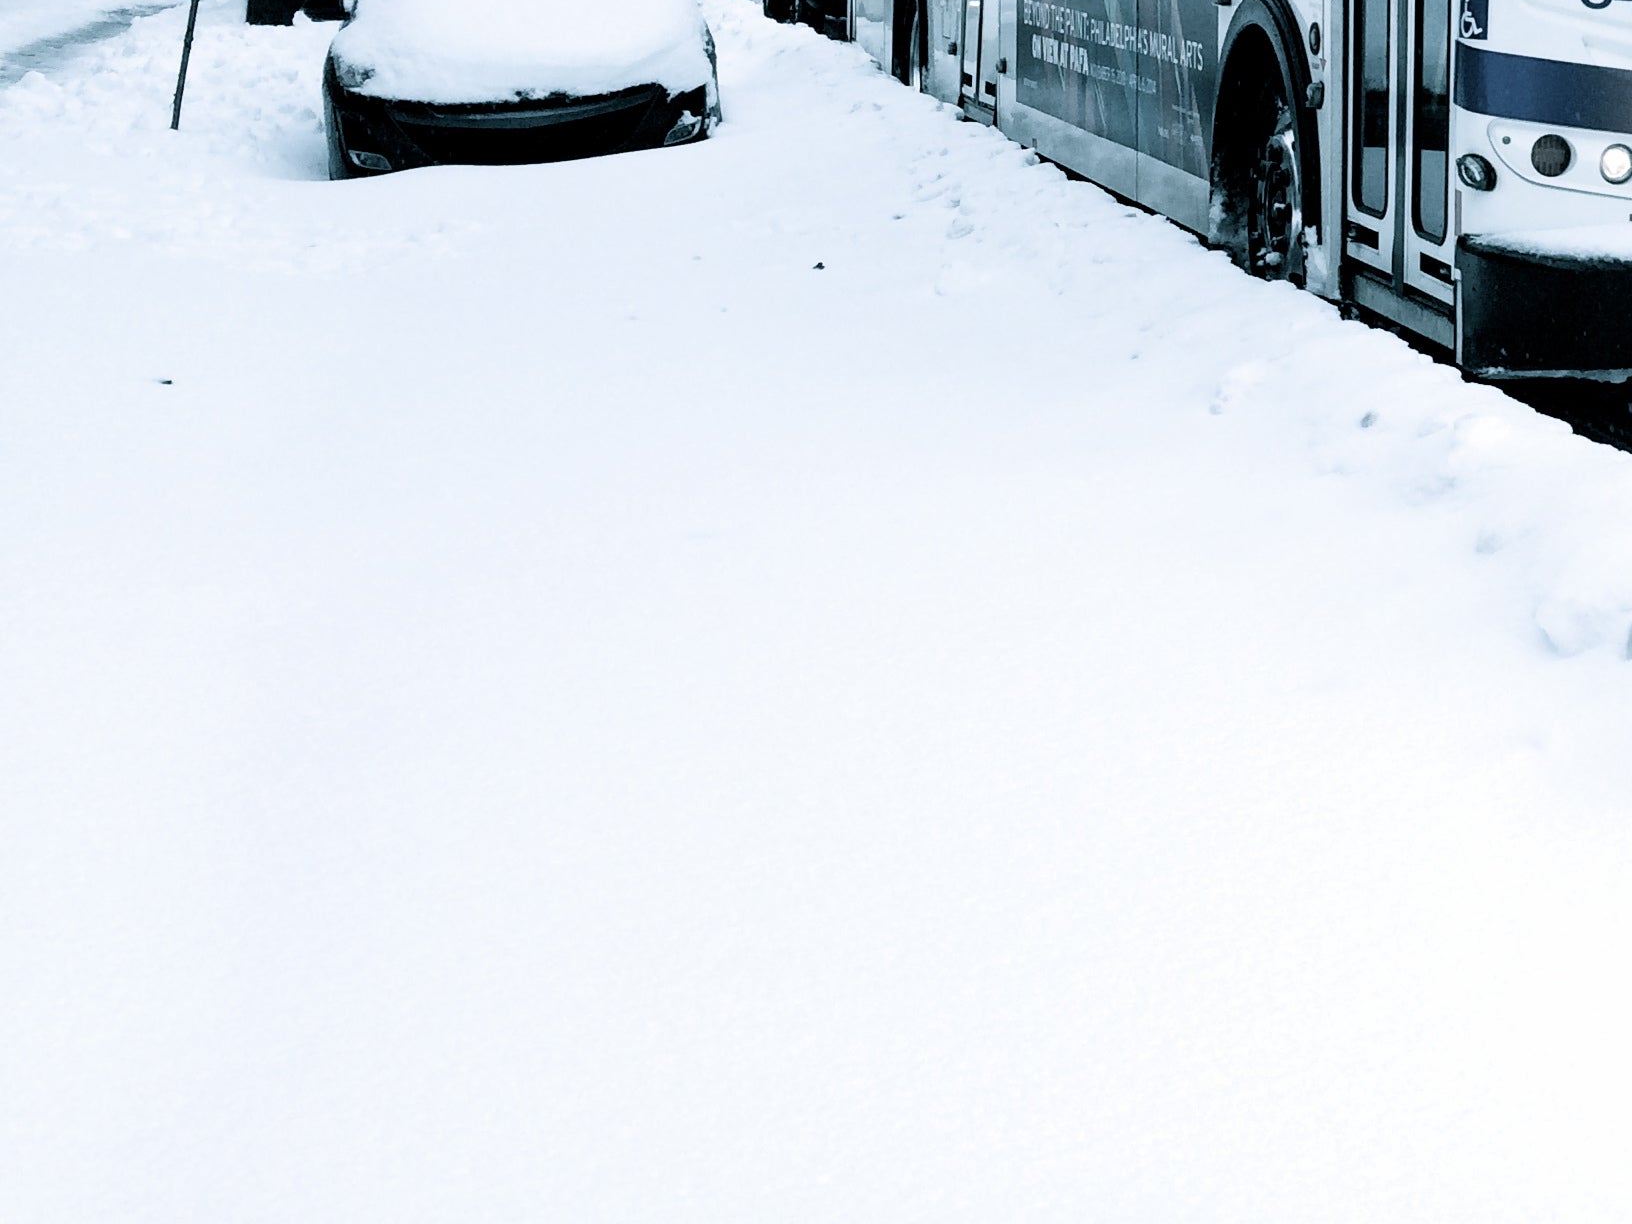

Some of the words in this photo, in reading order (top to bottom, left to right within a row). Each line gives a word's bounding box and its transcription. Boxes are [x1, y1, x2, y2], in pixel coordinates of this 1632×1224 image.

[1051, 4, 1065, 34] THE
[1149, 30, 1178, 64] MURAL
[1180, 39, 1204, 71] ARTS
